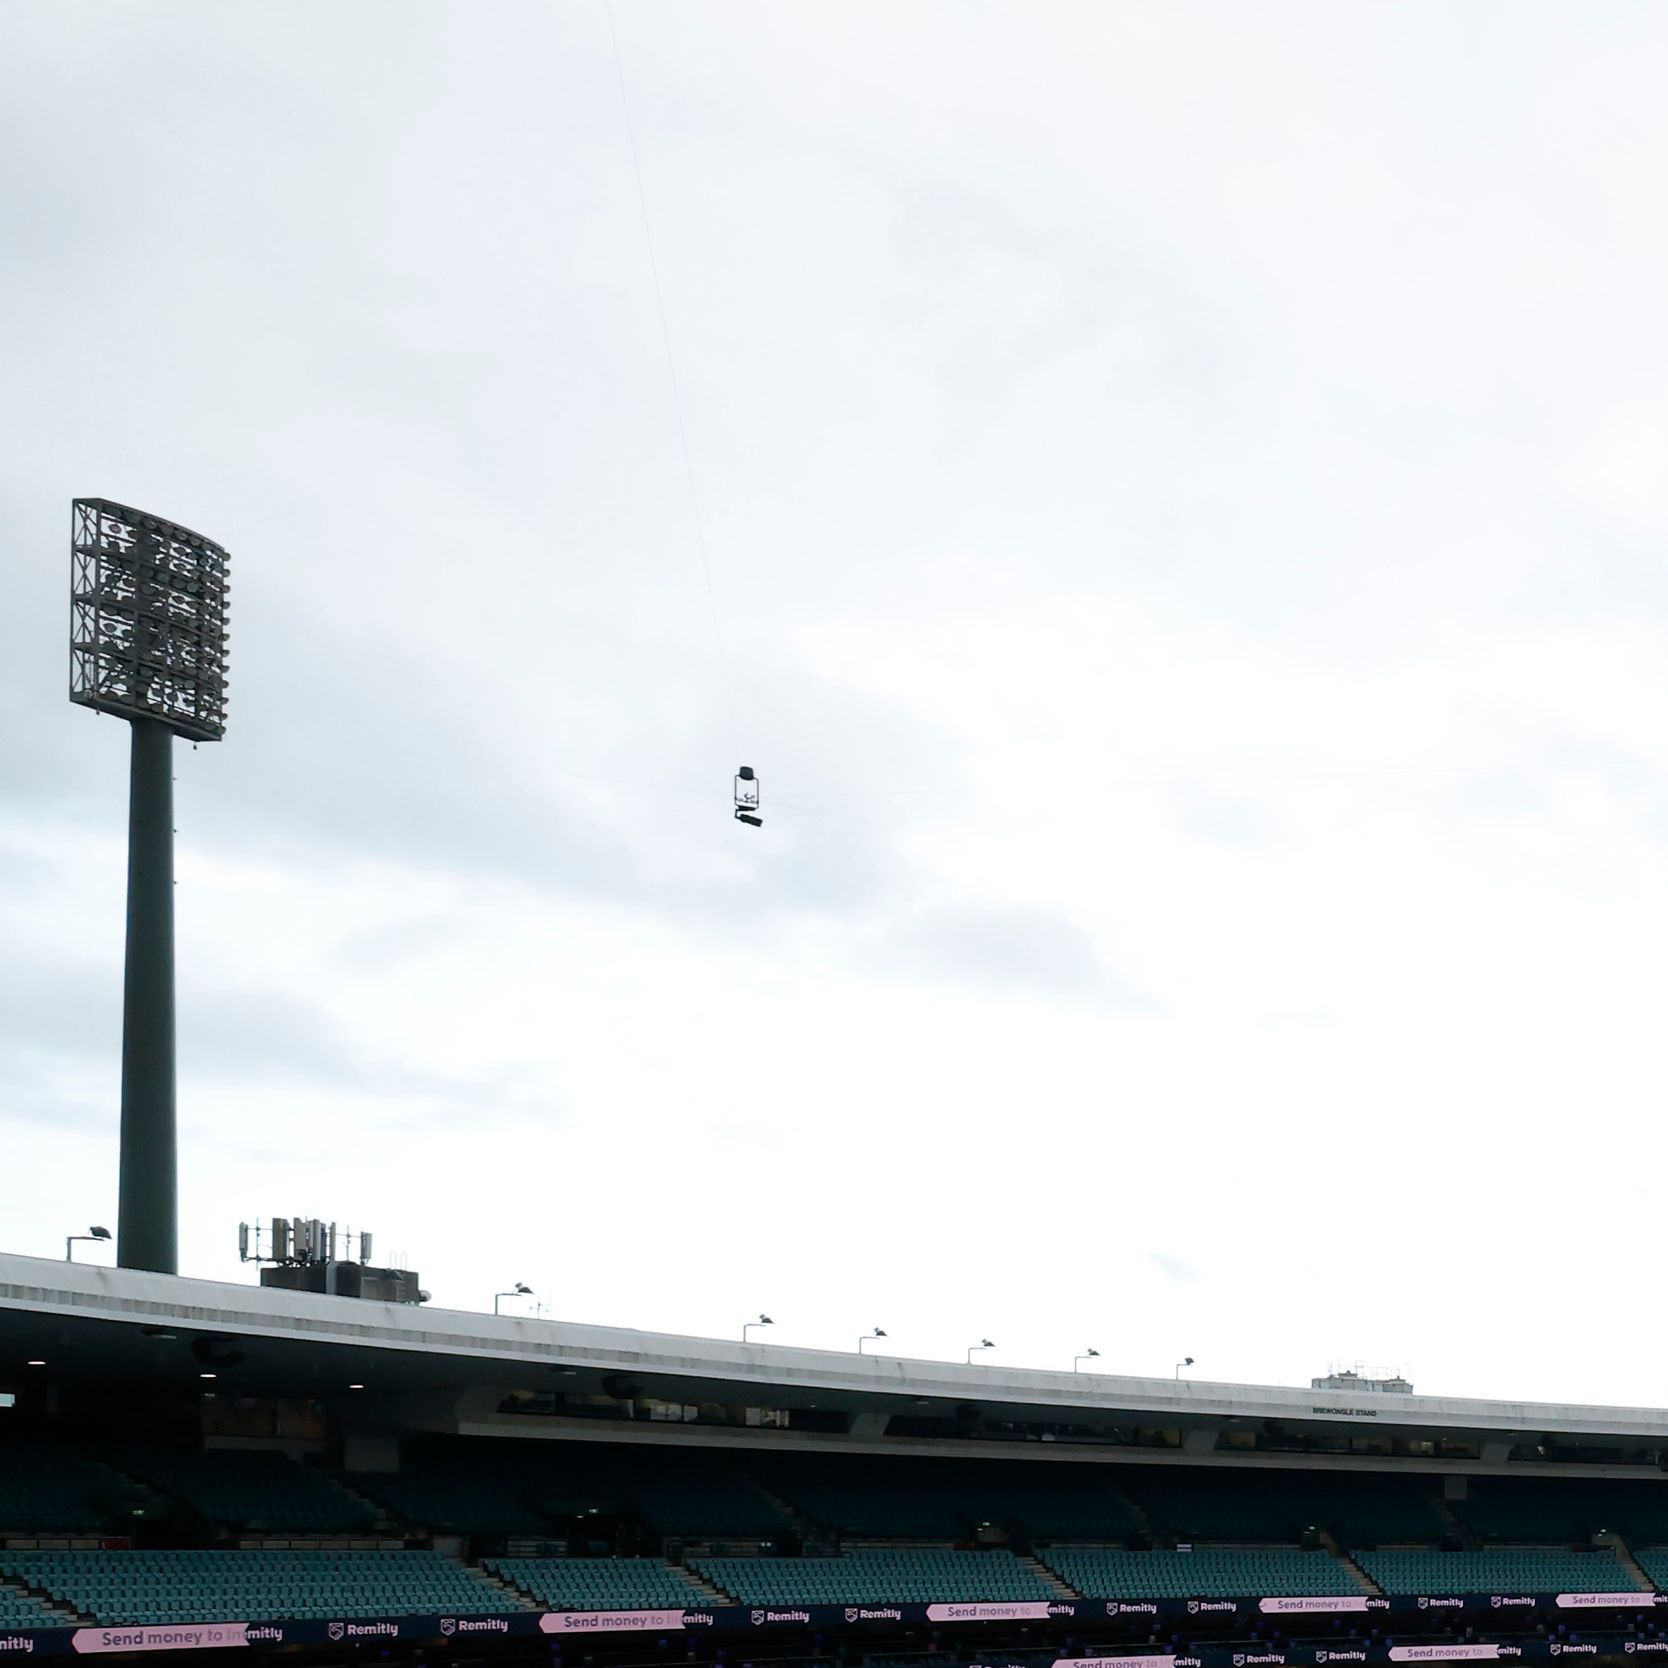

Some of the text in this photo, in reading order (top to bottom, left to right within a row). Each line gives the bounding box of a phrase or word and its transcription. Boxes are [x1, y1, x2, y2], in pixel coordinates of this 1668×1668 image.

[1278, 1600, 1338, 1610] Send money
[1502, 1597, 1535, 1607] Remitly
[860, 1608, 901, 1620] Remitly
[948, 1606, 1017, 1618] Send money
[1119, 1603, 1157, 1615] Remitly
[564, 1616, 598, 1628] Send
[602, 1614, 647, 1628] money
[767, 1610, 810, 1623] Remitly
[347, 1622, 398, 1637] Remitly
[458, 1620, 508, 1632] Remitly
[102, 1632, 143, 1646] Send
[148, 1630, 202, 1646] money
[1562, 1644, 1597, 1654] Remitly
[1246, 1653, 1285, 1664] Remitly
